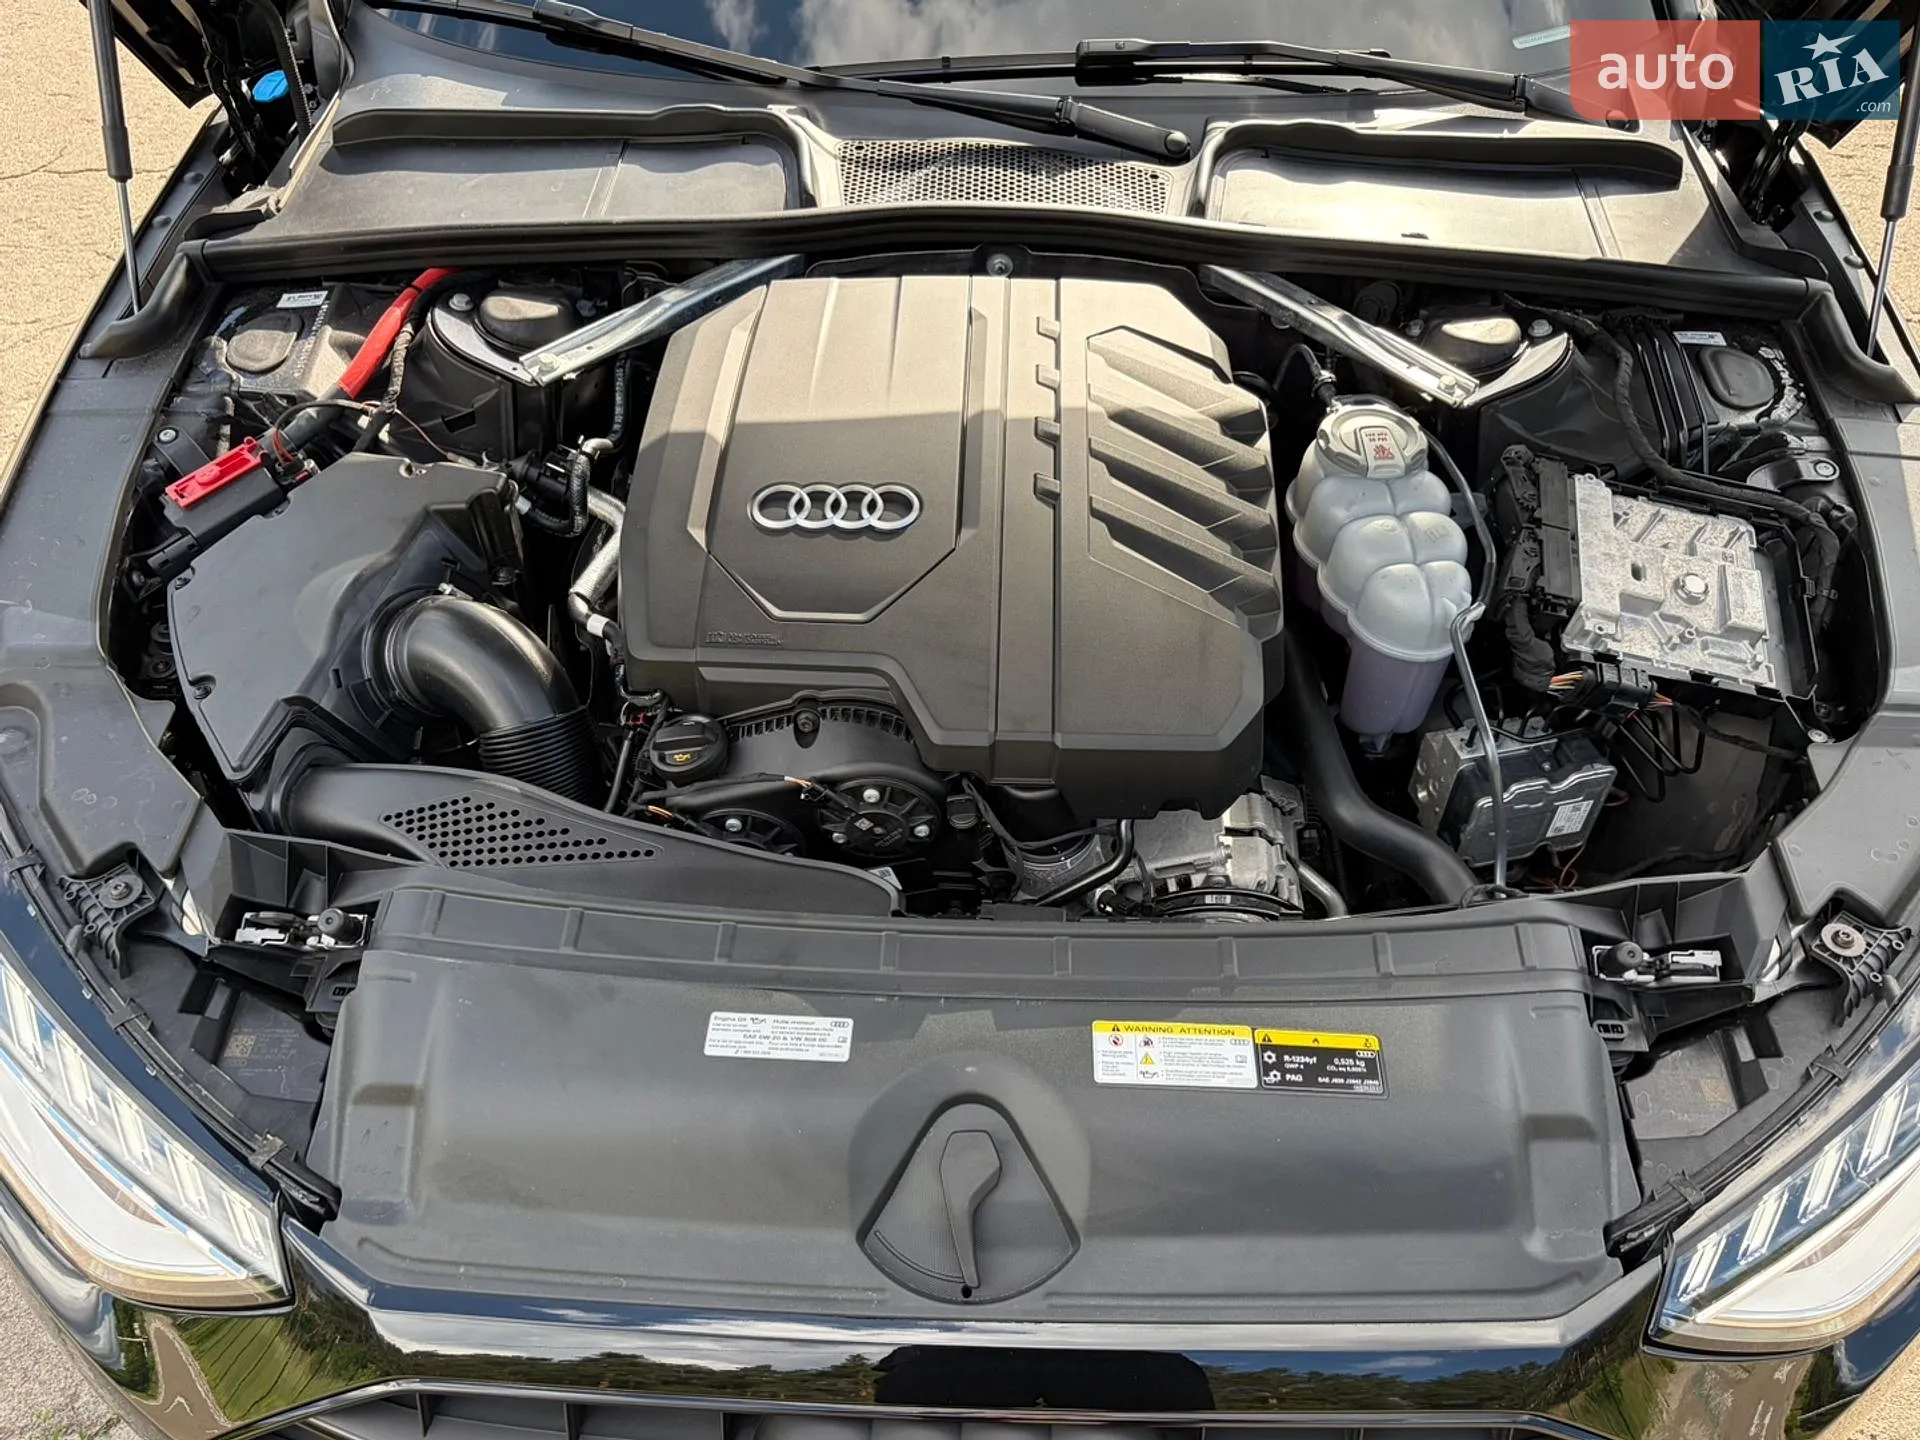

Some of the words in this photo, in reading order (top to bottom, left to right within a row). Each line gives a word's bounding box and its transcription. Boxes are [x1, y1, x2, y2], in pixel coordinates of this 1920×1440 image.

[1124, 1026, 1173, 1034] WARNING
[1180, 1027, 1235, 1036] ATTENTION
[1283, 1054, 1317, 1065] R-1234yf
[1285, 1074, 1303, 1082] PAG
